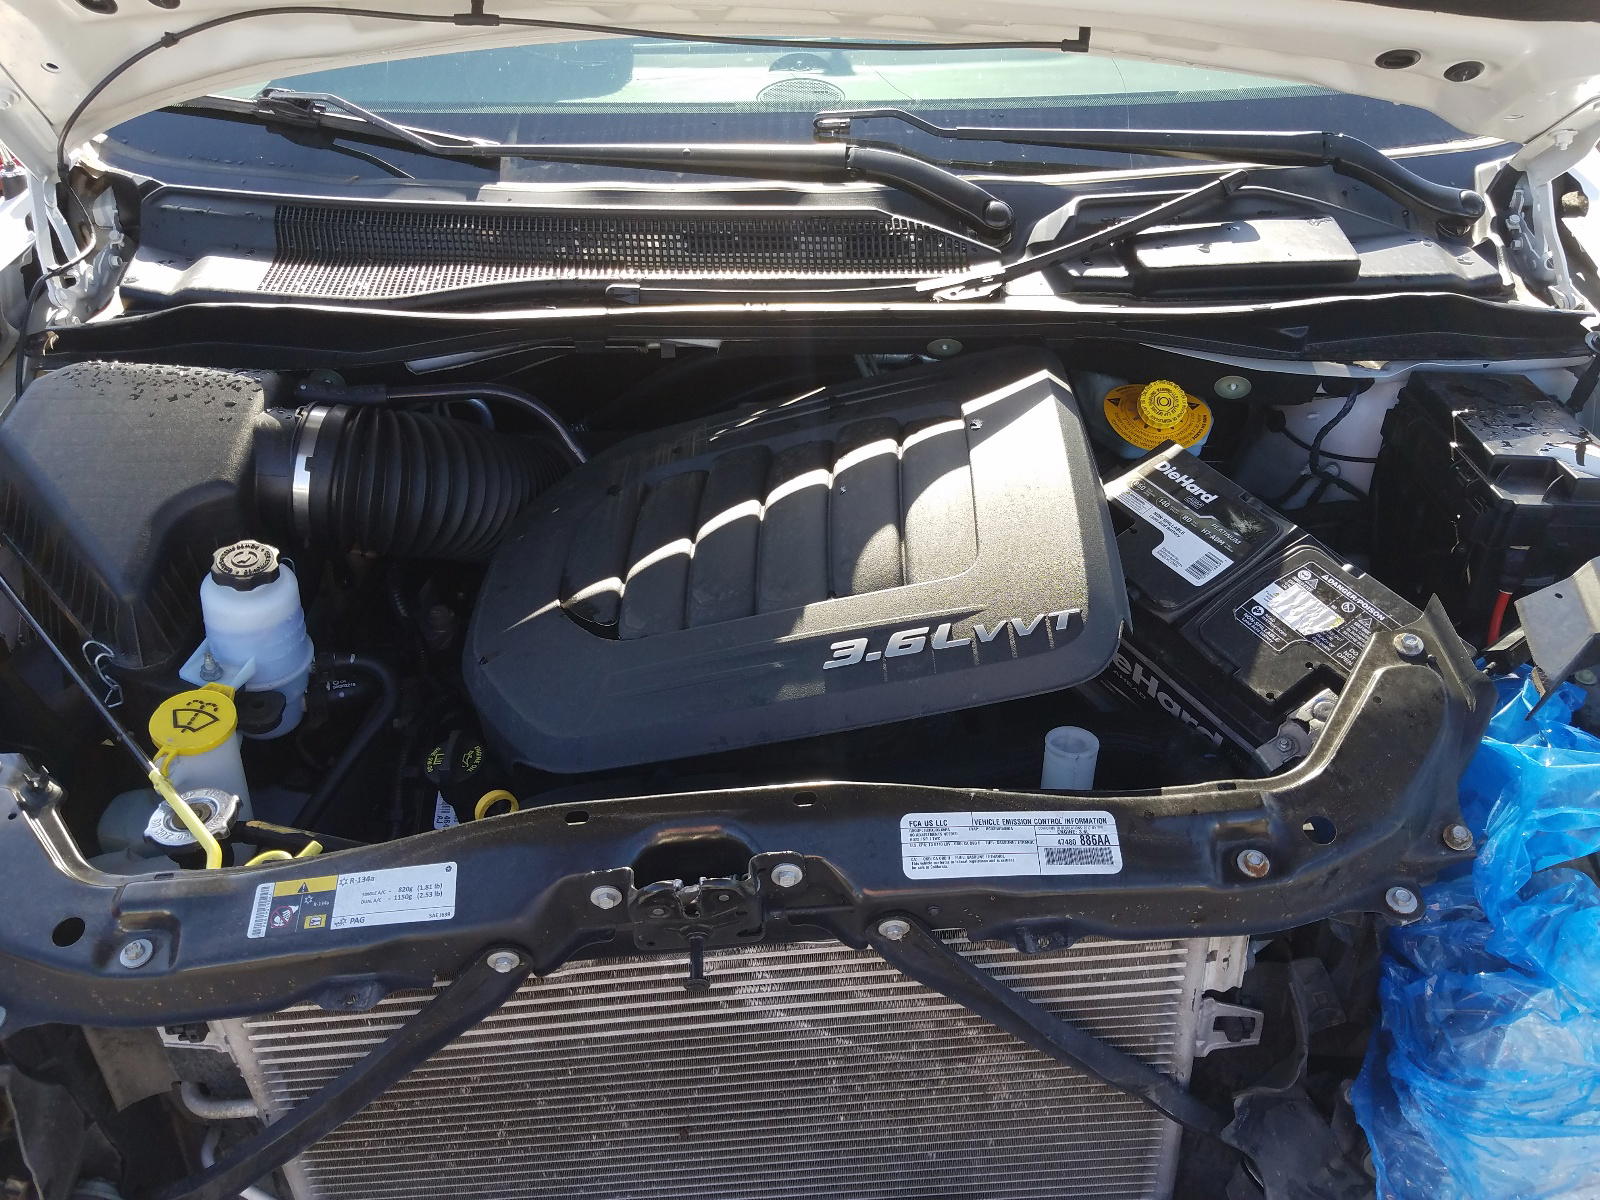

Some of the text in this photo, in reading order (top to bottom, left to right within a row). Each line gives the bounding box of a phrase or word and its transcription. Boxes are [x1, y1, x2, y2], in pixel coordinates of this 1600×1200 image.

[1154, 460, 1219, 504] DieHard
[1159, 498, 1170, 508] 140
[1182, 514, 1193, 523] 80
[1211, 523, 1241, 545] PLATINUM
[1328, 579, 1385, 620] DANGER/POISON
[823, 608, 1082, 670] 3.6L VVT
[1343, 650, 1356, 661] NOT
[1349, 648, 1359, 656] DO
[1113, 652, 1224, 746] eHard
[909, 819, 948, 828] FCA US LLC
[974, 818, 1000, 826] VEHICLE
[1033, 817, 1062, 825] CONTROL
[1064, 817, 1107, 825] INFORMATION
[1080, 834, 1111, 846] 886AA
[350, 876, 375, 884] R-134a
[398, 886, 413, 894] 820g
[417, 883, 433, 892] (1.81
[434, 882, 443, 891] lb)
[394, 893, 412, 901] 1150g
[416, 891, 433, 900] (2.53
[434, 890, 443, 898] lb)
[349, 916, 365, 924] PAG
